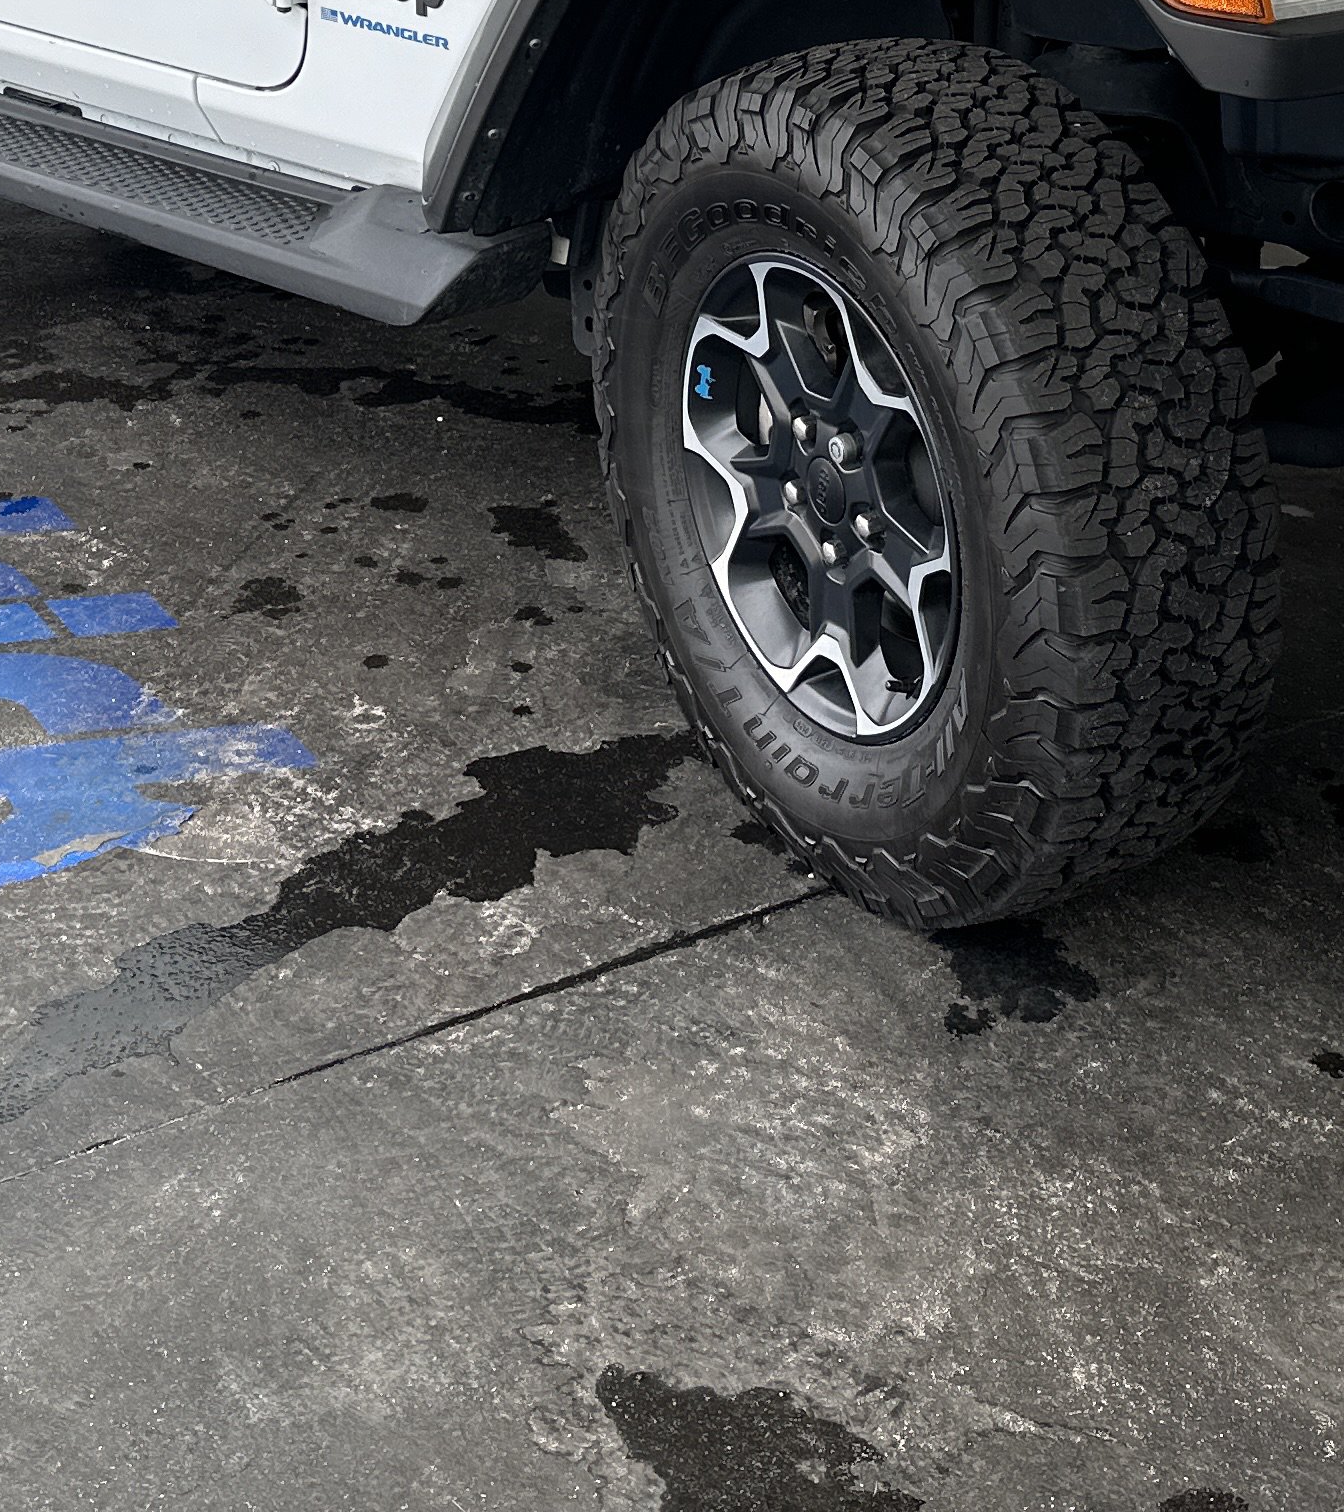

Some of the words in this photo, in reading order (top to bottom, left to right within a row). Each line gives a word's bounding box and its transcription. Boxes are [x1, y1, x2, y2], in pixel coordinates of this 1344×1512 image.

[340, 11, 450, 50] WRANGLER
[642, 197, 897, 334] BFGoodrich
[743, 667, 969, 809] All-Terrain
